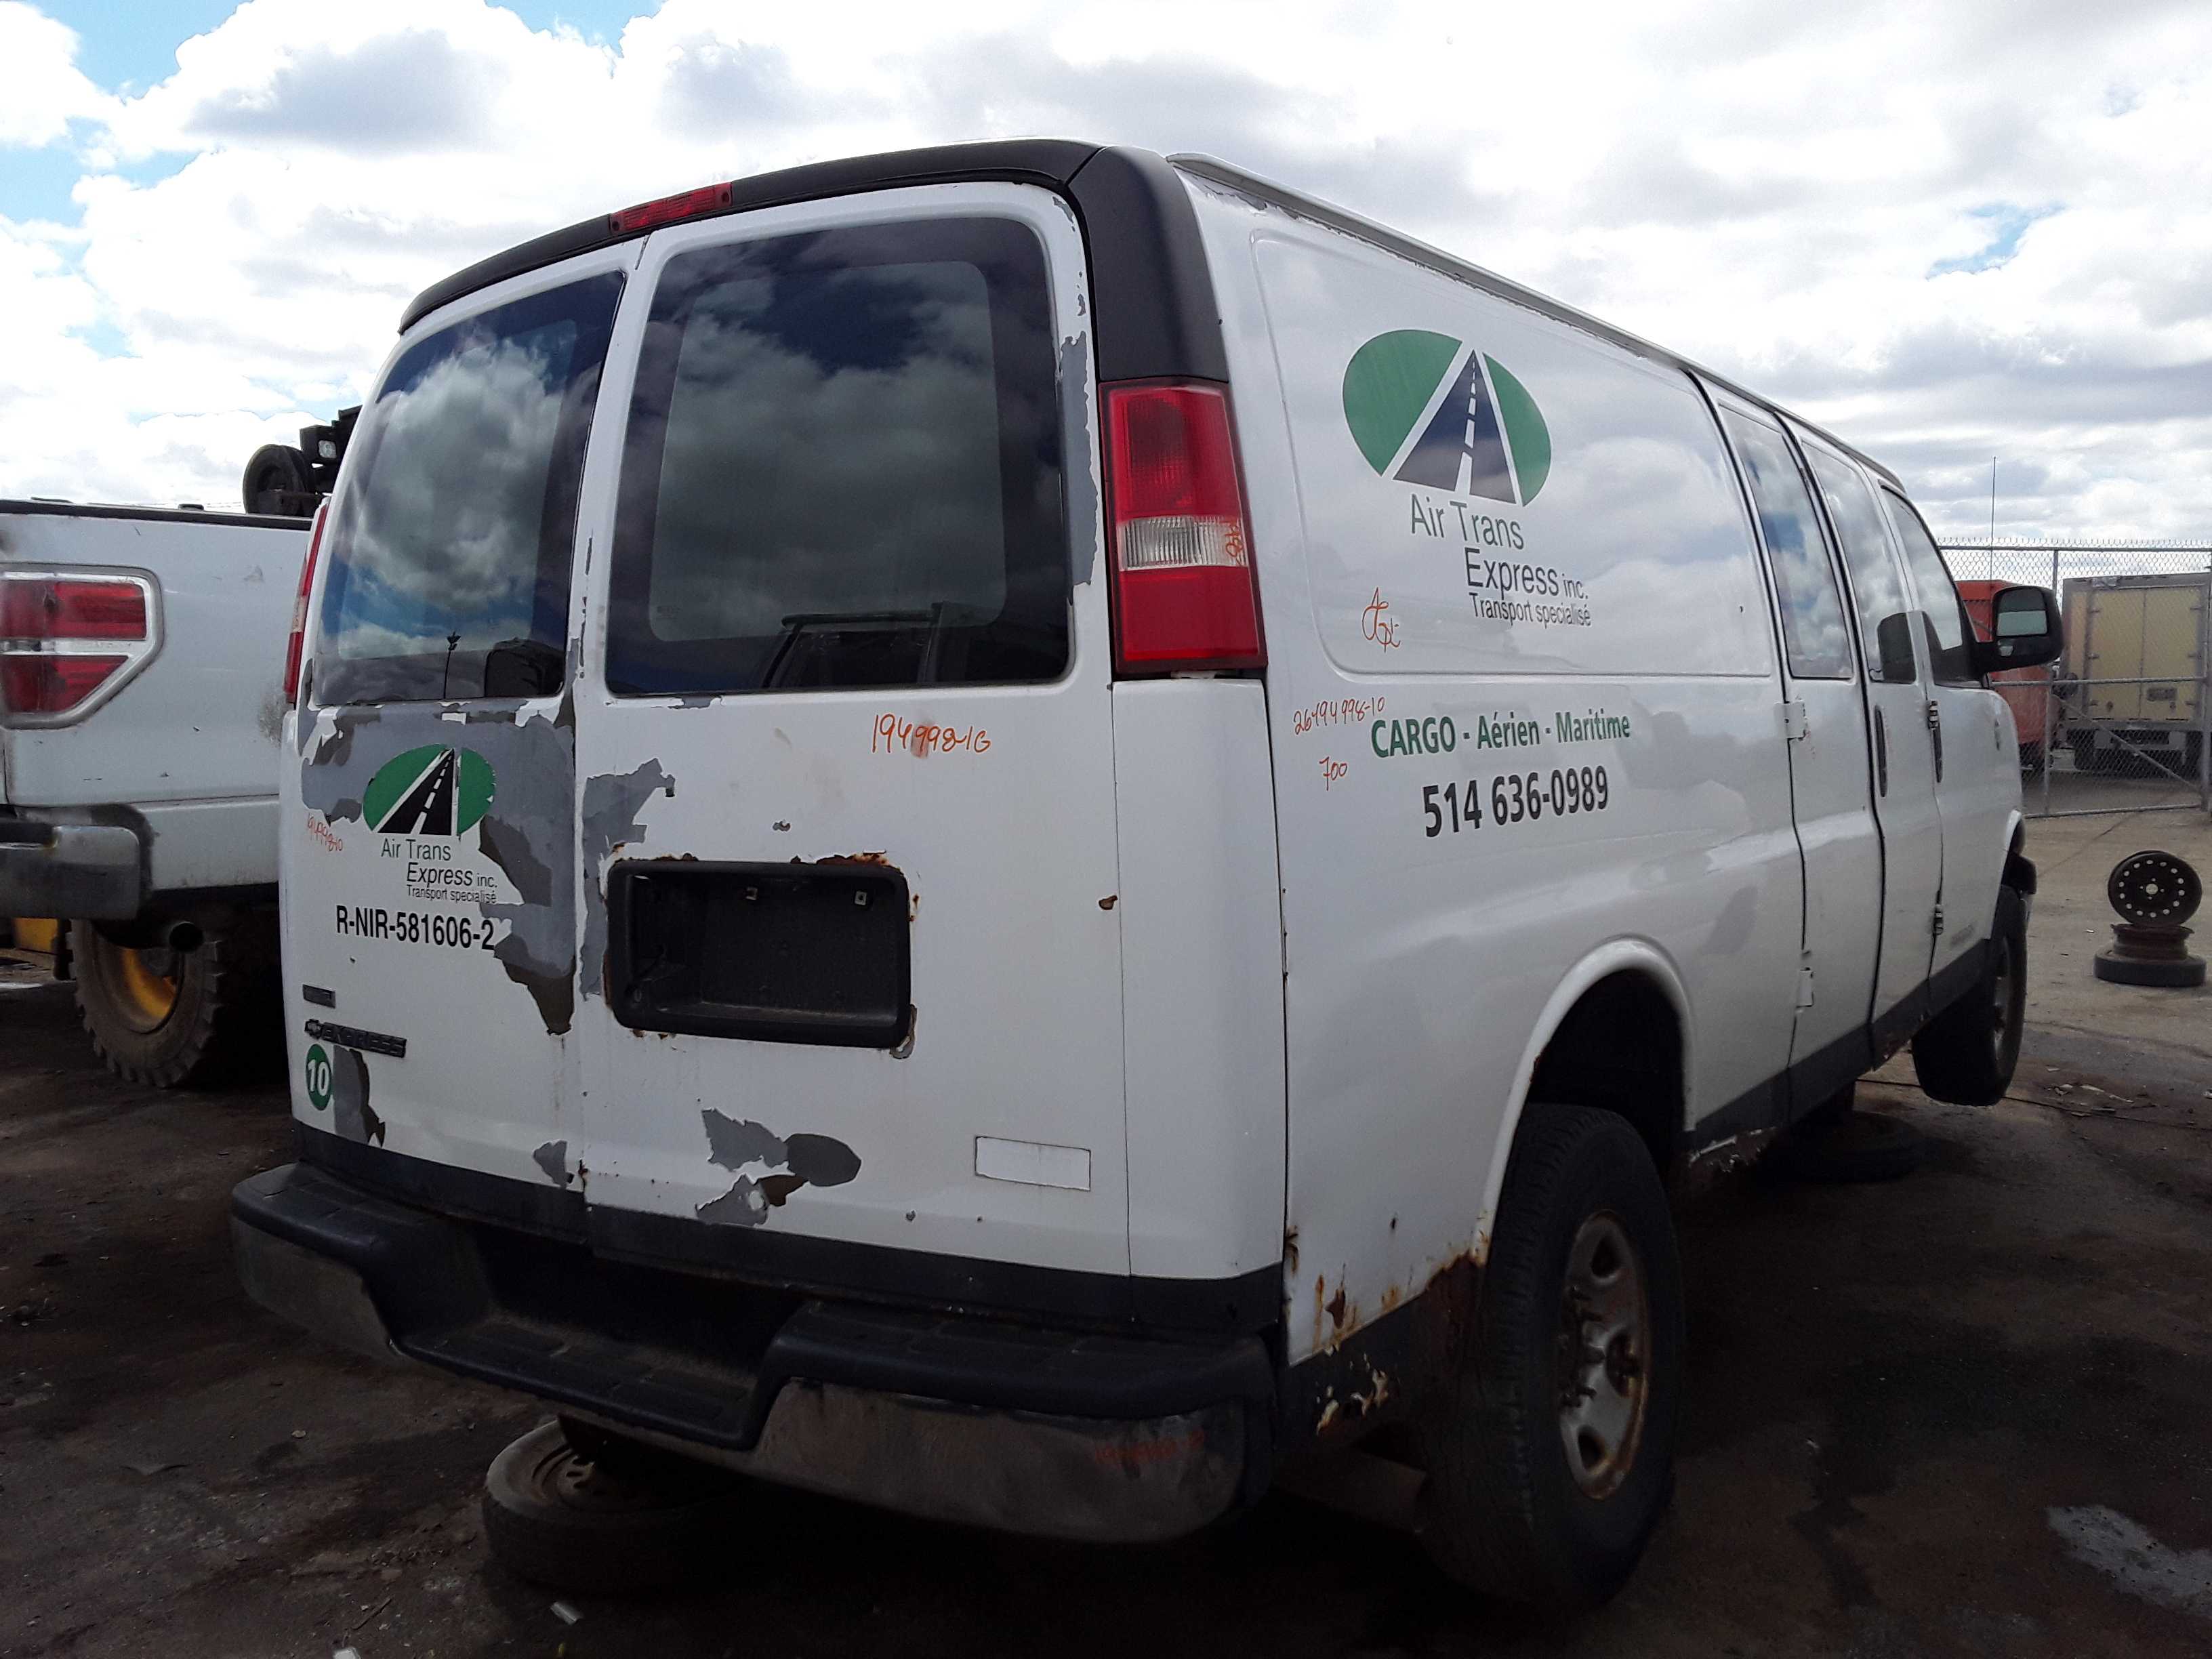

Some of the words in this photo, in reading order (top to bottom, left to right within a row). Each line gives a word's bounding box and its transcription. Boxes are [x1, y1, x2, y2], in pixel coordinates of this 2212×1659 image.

[1411, 493, 1445, 539] Air
[1450, 500, 1524, 550] Trans
[1465, 547, 1559, 600] Express
[1562, 573, 1589, 600] inc.
[1469, 592, 1533, 626] Transport
[1371, 716, 1456, 758] CARGO
[1477, 711, 1540, 750] Aérien
[1555, 708, 1631, 743] Maritime
[1319, 756, 1348, 791] 700
[1423, 779, 1483, 838] 514
[1492, 764, 1609, 825] 636-0989
[381, 838, 401, 859] Air
[406, 838, 451, 861] Trans
[406, 884, 448, 901] Transport
[407, 861, 474, 888] Express
[476, 872, 498, 888] inc.
[336, 905, 495, 950] R-NIR-581606-2
[307, 1059, 331, 1097] 10
